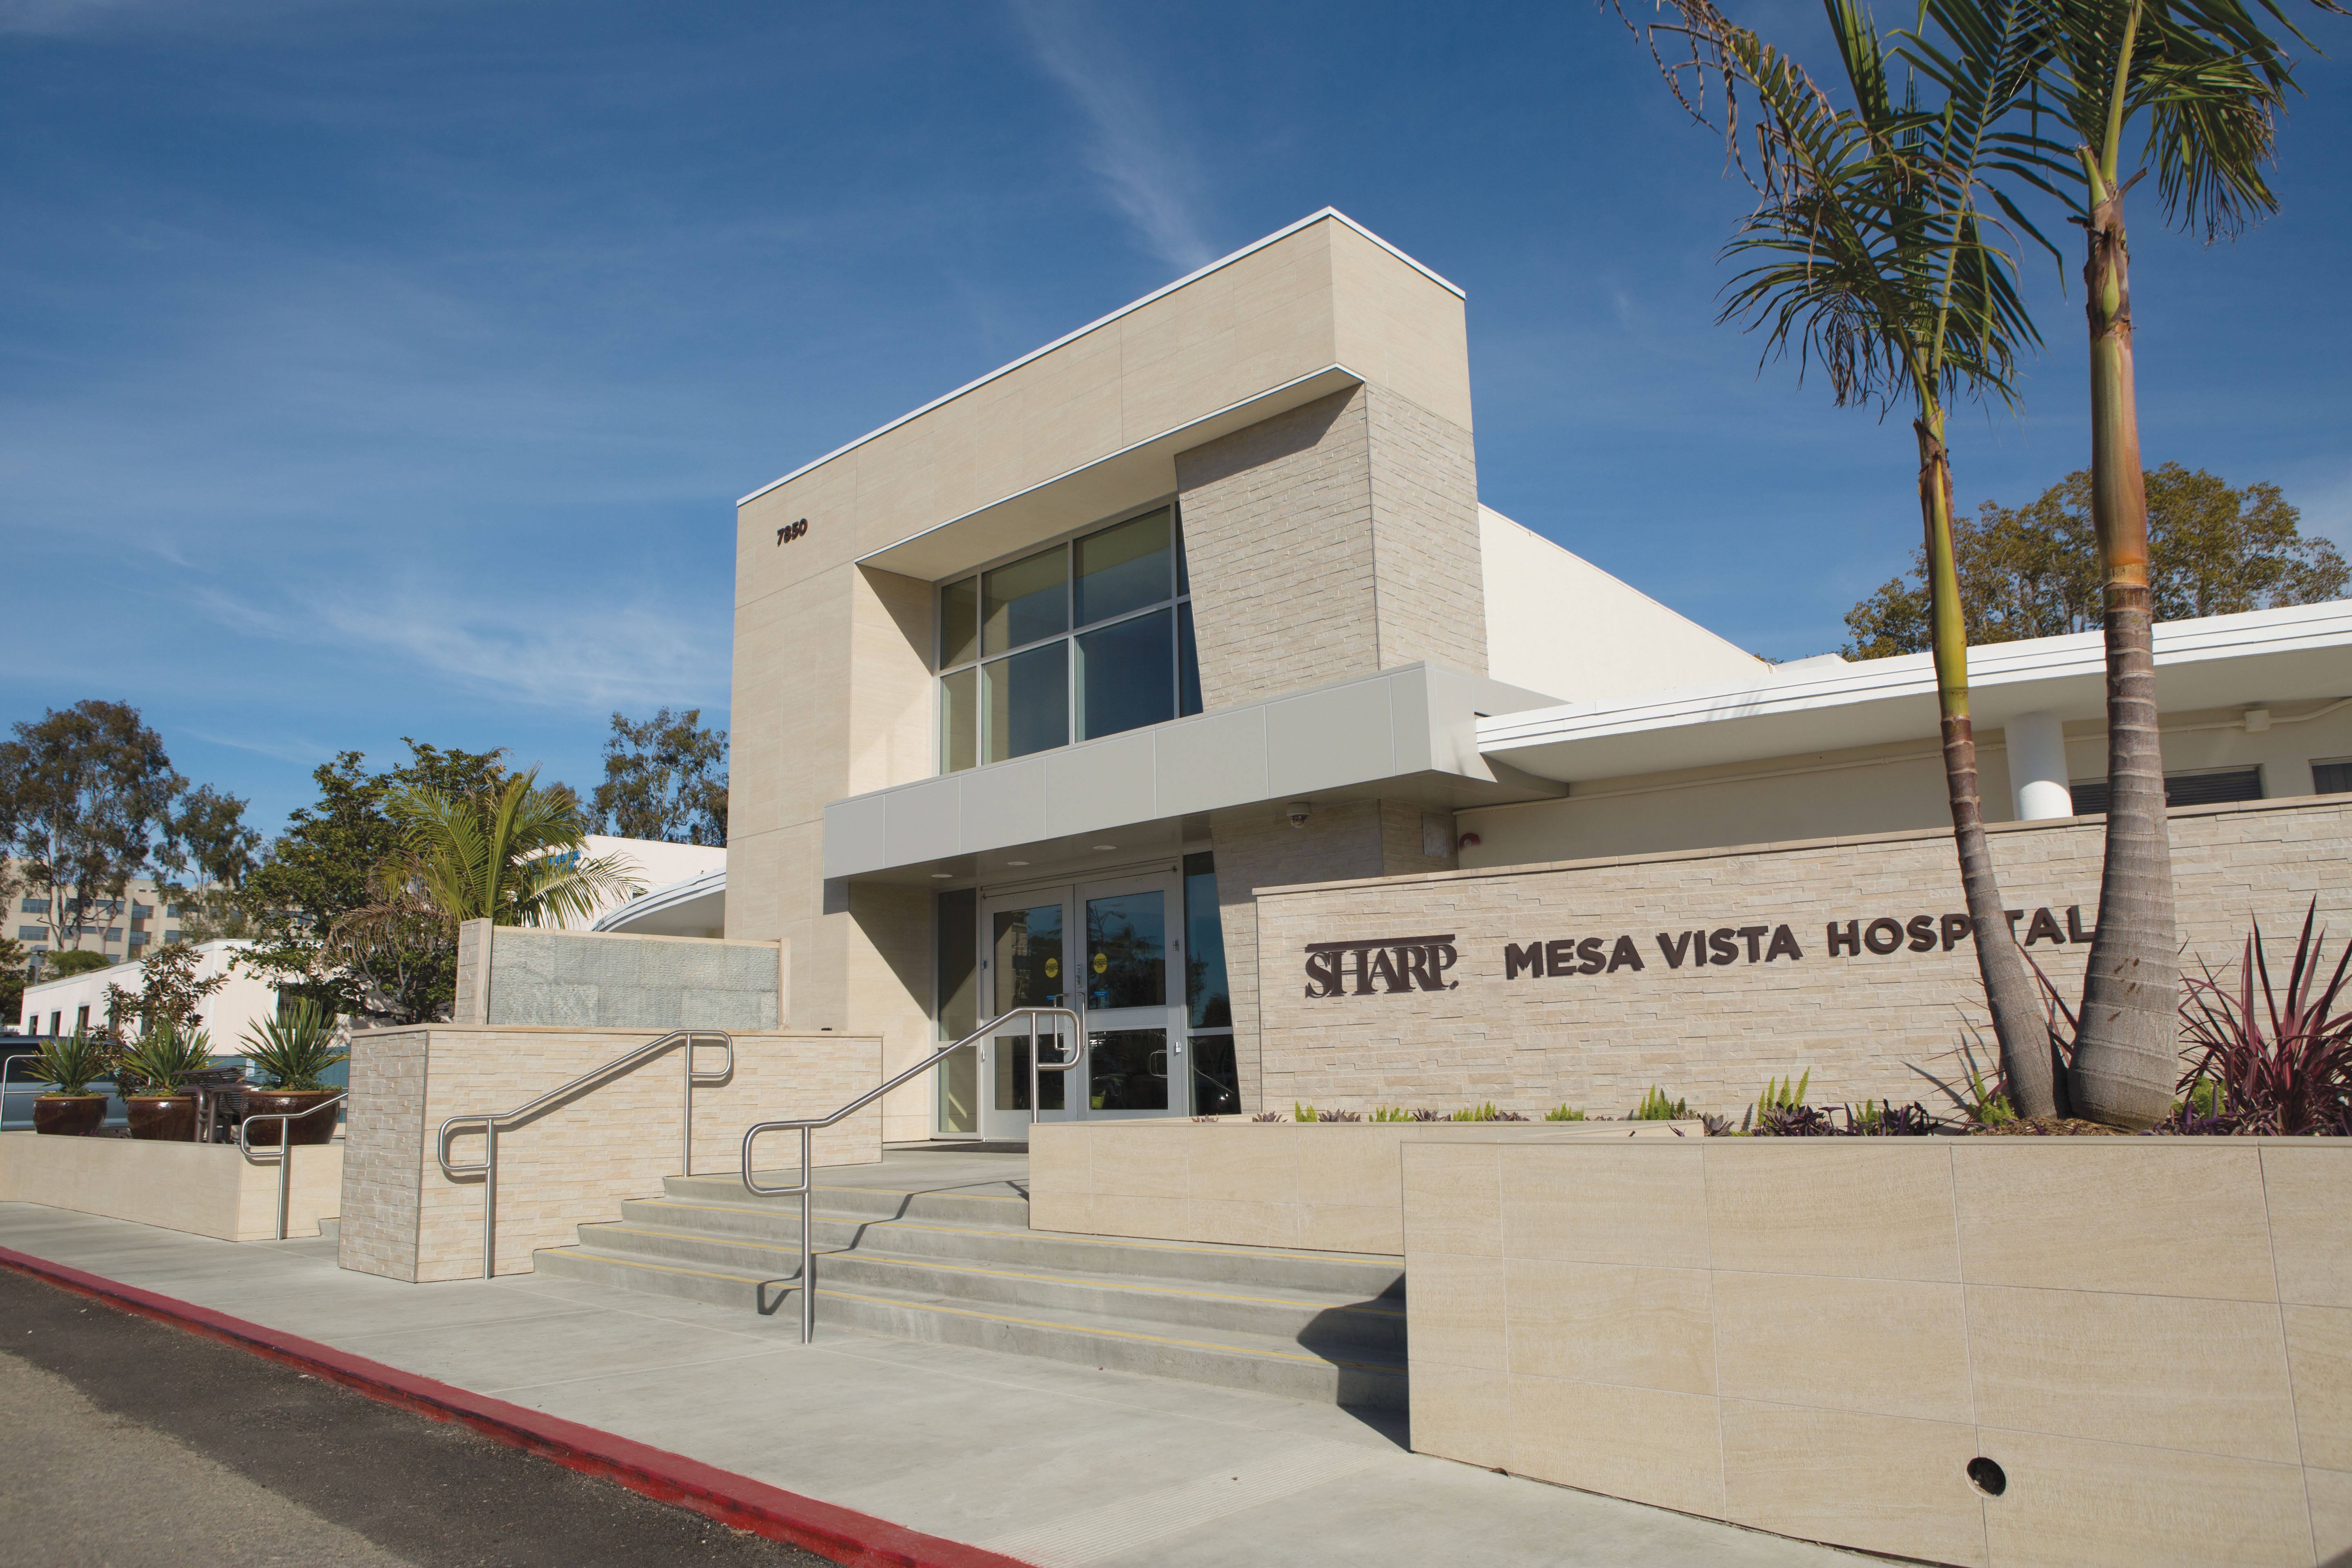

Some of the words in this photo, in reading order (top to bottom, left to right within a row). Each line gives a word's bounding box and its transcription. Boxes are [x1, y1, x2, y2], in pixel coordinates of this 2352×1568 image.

[777, 518, 808, 547] 7850
[1506, 935, 1645, 978] MESA
[1658, 924, 1804, 968] VISTA
[1827, 905, 2096, 956] HOSPTAL
